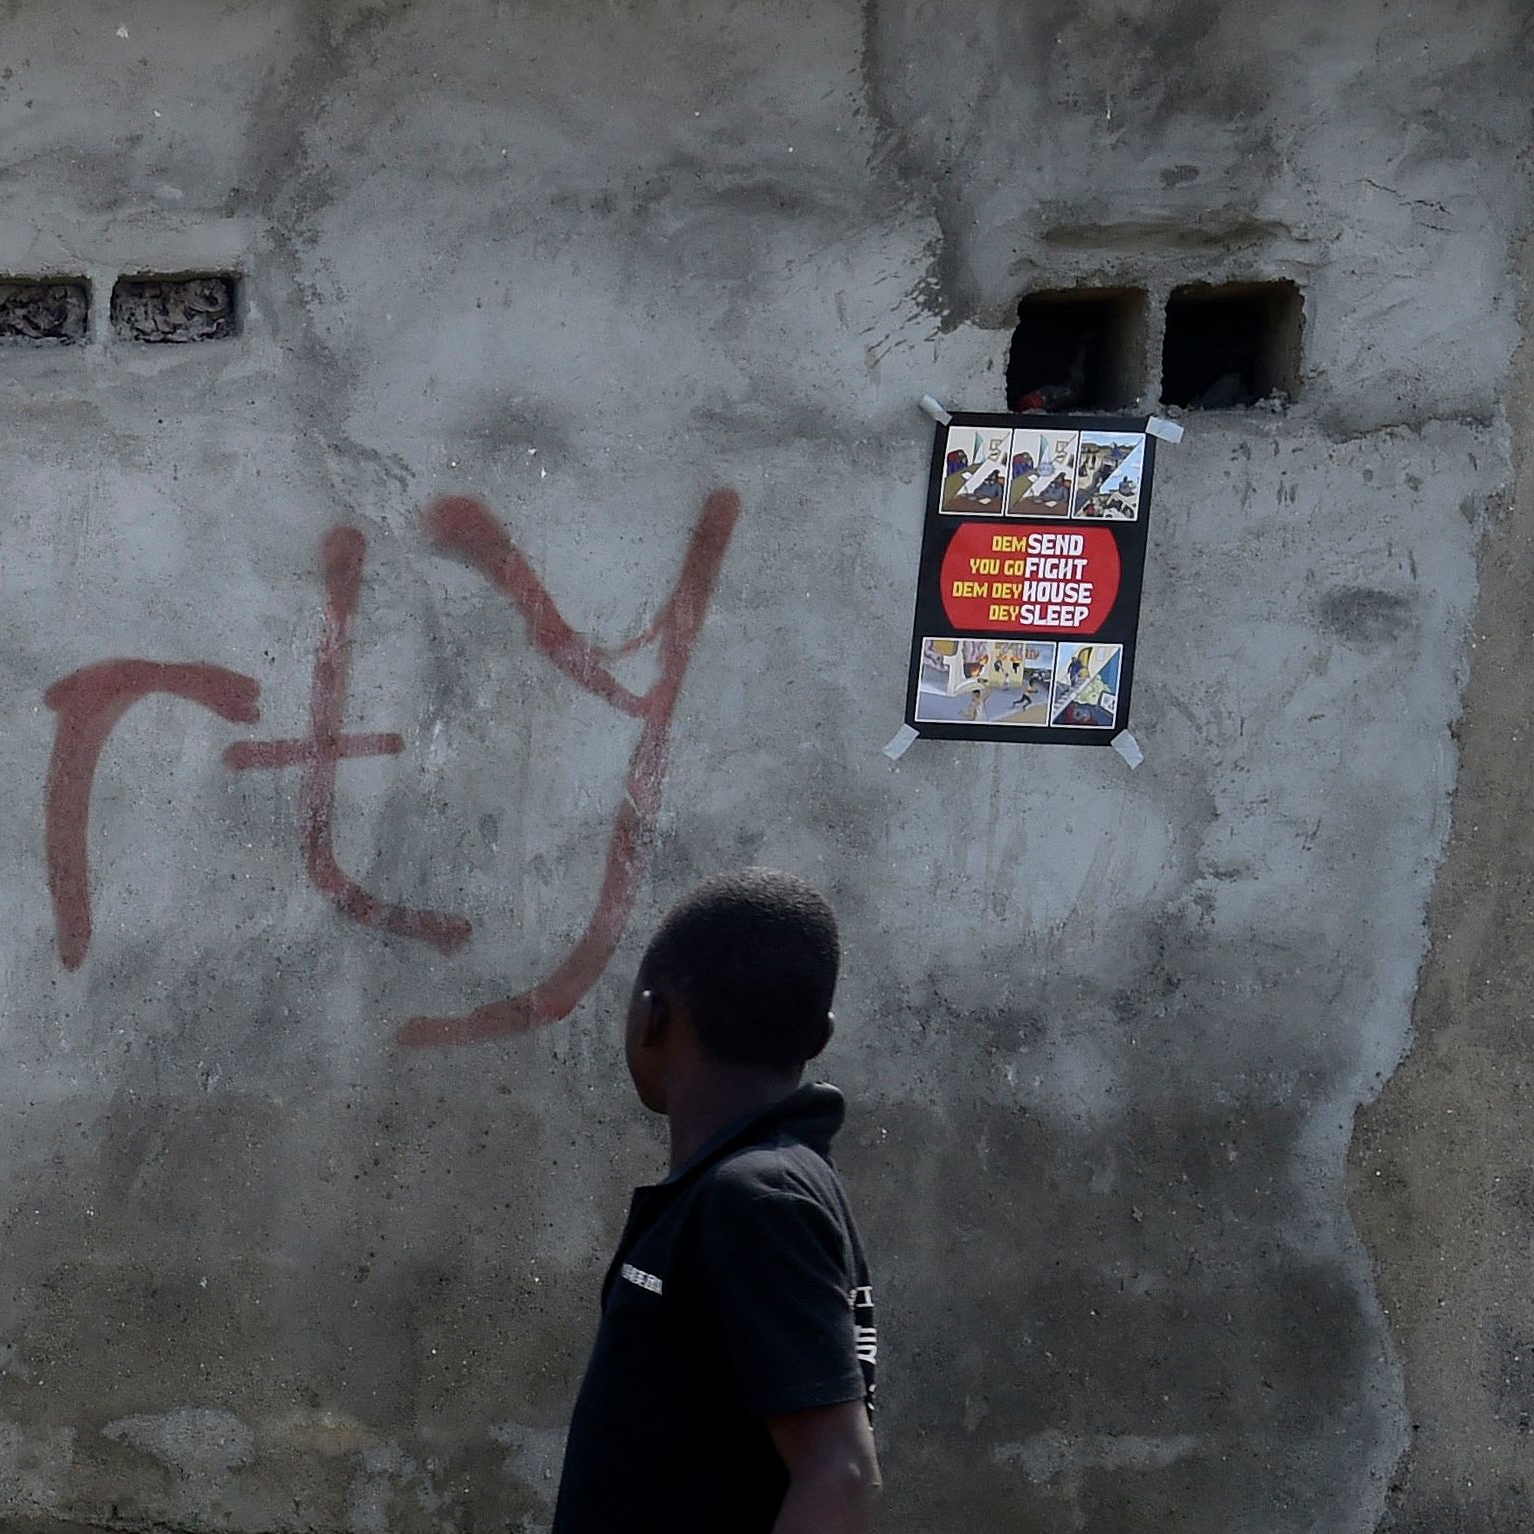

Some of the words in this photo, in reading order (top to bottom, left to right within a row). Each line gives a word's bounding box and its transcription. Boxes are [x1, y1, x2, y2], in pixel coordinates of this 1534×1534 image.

[991, 535, 1027, 552] DEM
[1026, 533, 1084, 556] SEND
[969, 558, 1000, 575] YOU
[1003, 559, 1025, 576] GO
[1024, 557, 1088, 580] FIGHT
[952, 581, 989, 598] DEM
[991, 582, 1023, 599] DEY
[1022, 580, 1093, 604] HOUSE
[988, 604, 1020, 621] DEY
[1019, 604, 1089, 627] SLEEP
